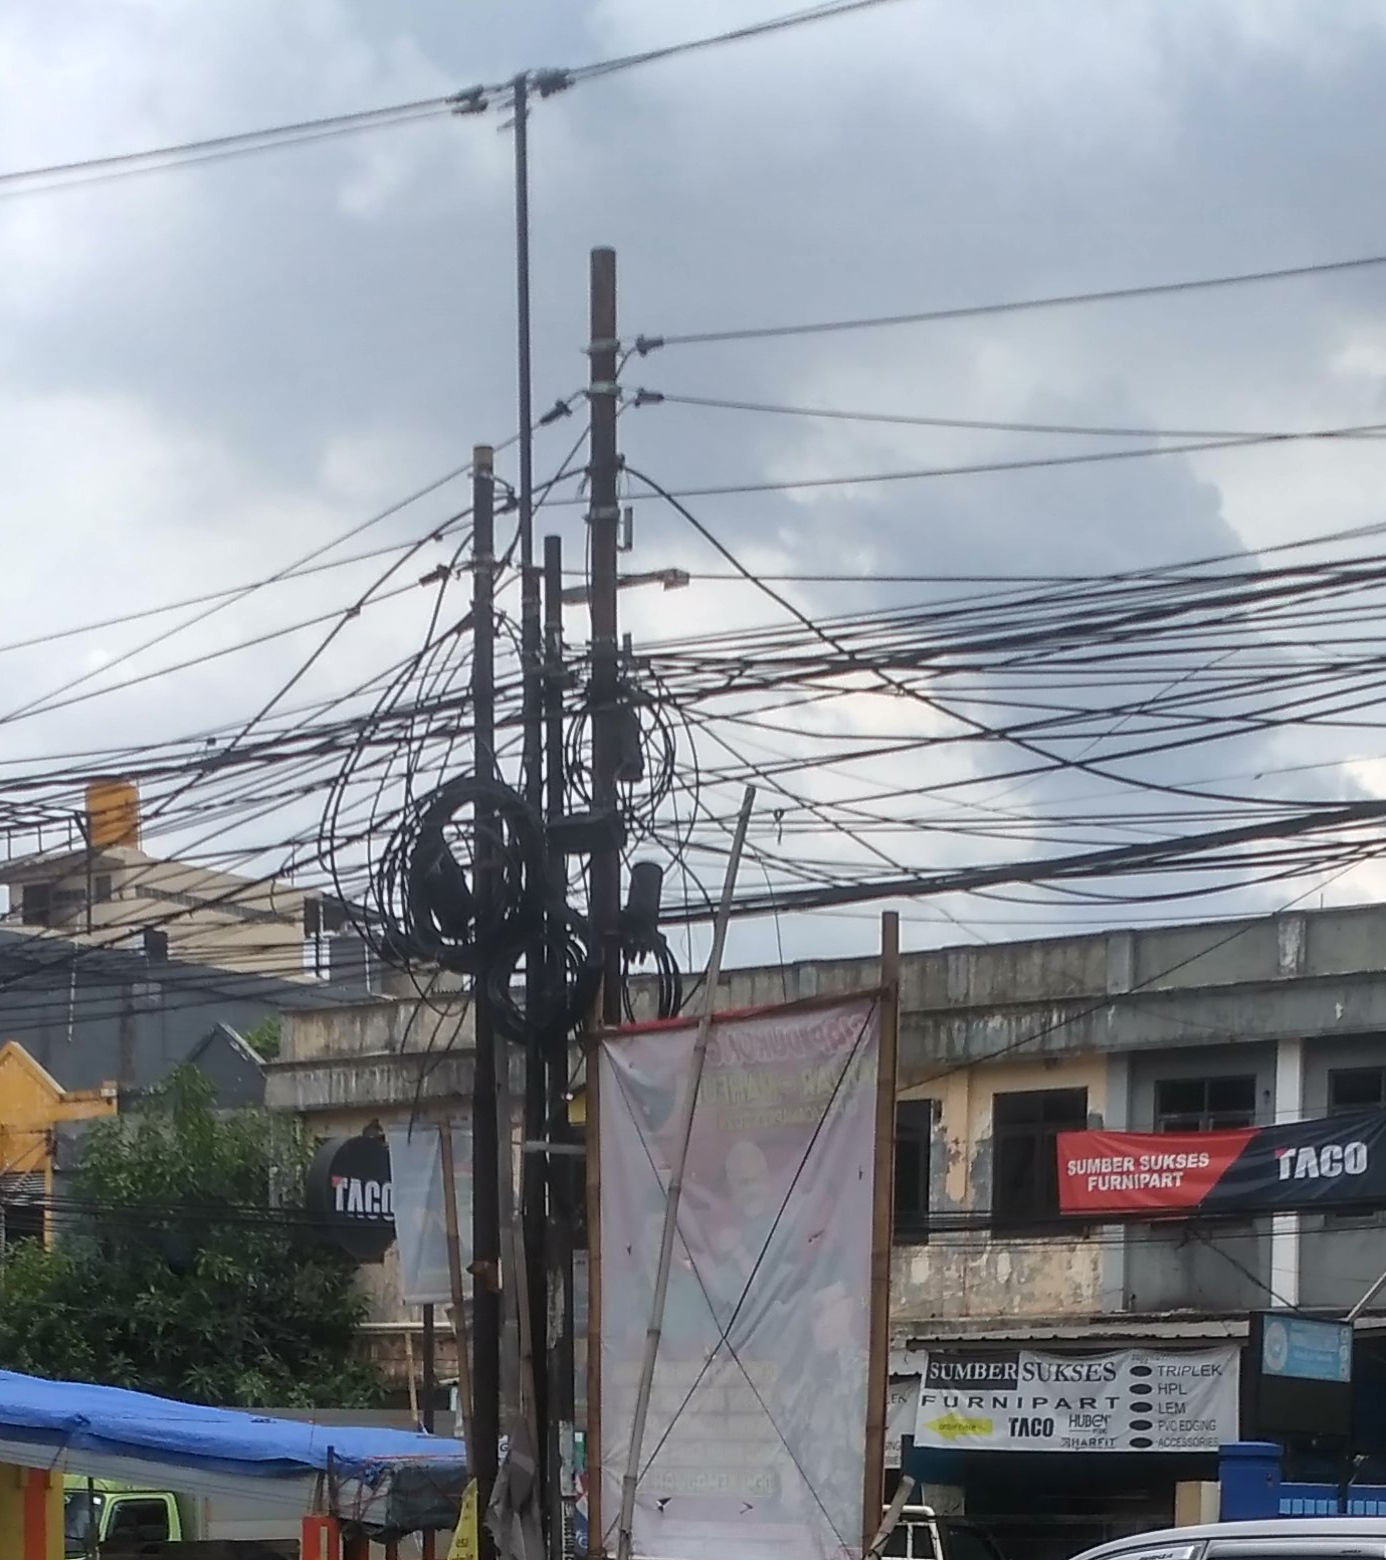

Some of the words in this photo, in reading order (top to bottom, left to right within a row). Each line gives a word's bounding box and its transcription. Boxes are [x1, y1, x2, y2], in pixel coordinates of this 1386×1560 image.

[1067, 1157, 1135, 1175] SUMBER
[1138, 1153, 1211, 1171] SUKSES
[1275, 1141, 1367, 1181] TACO
[1087, 1172, 1184, 1192] FURNIPART
[332, 1176, 394, 1221] TACO
[930, 1361, 1018, 1381] SUMBER
[1022, 1361, 1117, 1382] SUKSES
[1158, 1364, 1222, 1377] TRIPLEK
[1158, 1383, 1187, 1395] HPL
[921, 1395, 1120, 1410] FURNIPART
[1158, 1402, 1186, 1414] LEM
[1008, 1417, 1054, 1437] TACO
[1179, 1420, 1217, 1431] EDGING
[1158, 1437, 1219, 1448] ACCESSORIES
